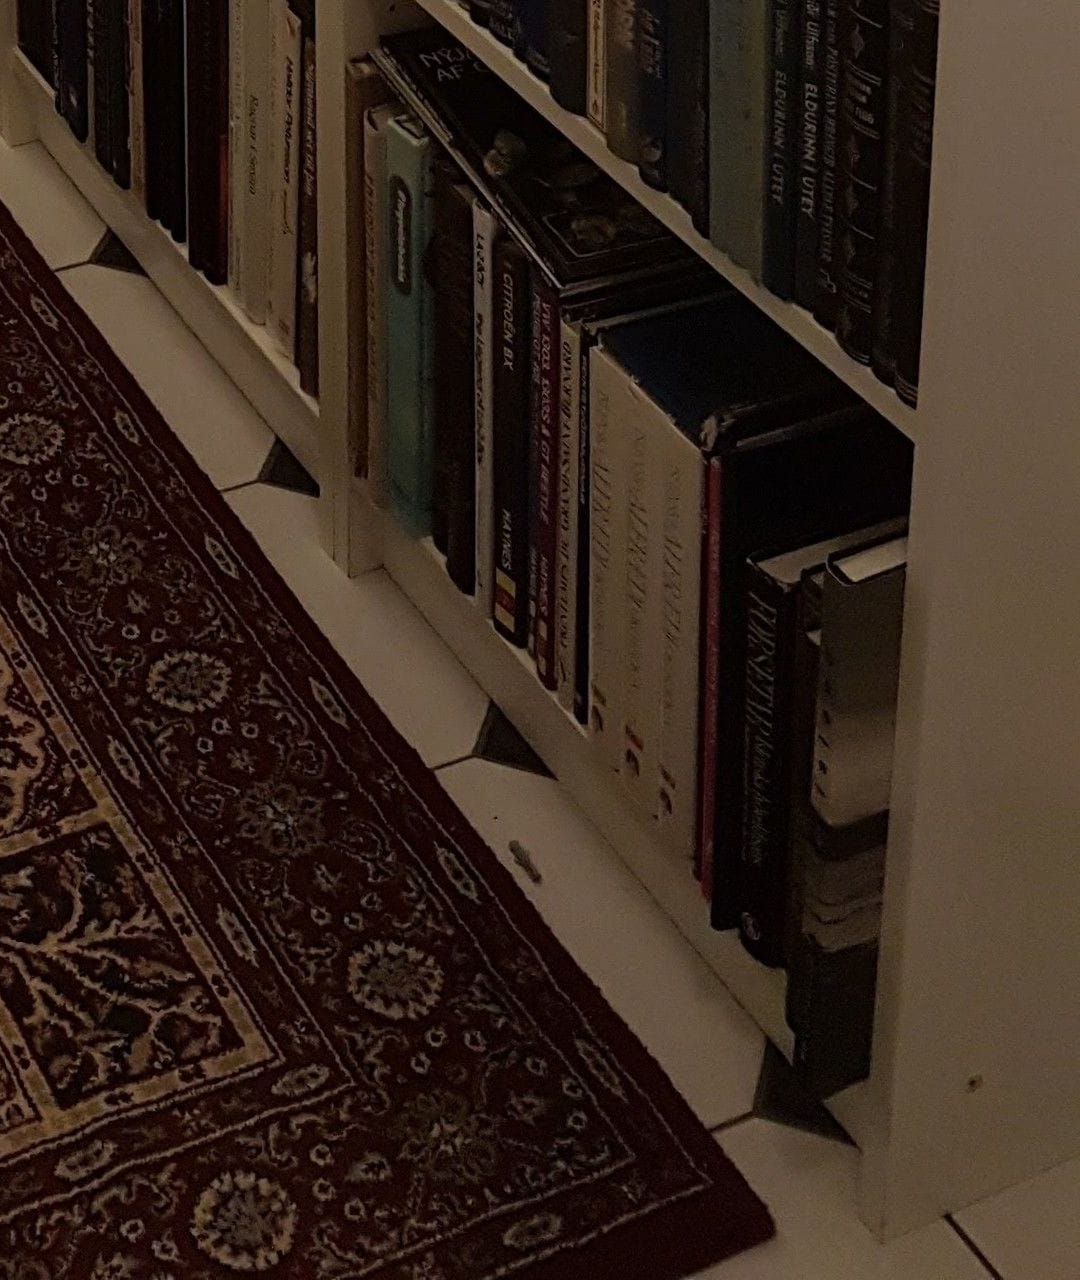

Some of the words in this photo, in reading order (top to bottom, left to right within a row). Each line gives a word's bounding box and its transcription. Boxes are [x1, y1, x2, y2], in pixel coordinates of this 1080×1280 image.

[803, 82, 820, 162] ELDURINN
[502, 271, 516, 344] CITROËN
[502, 345, 515, 373] BX
[500, 507, 513, 572] HAYNES
